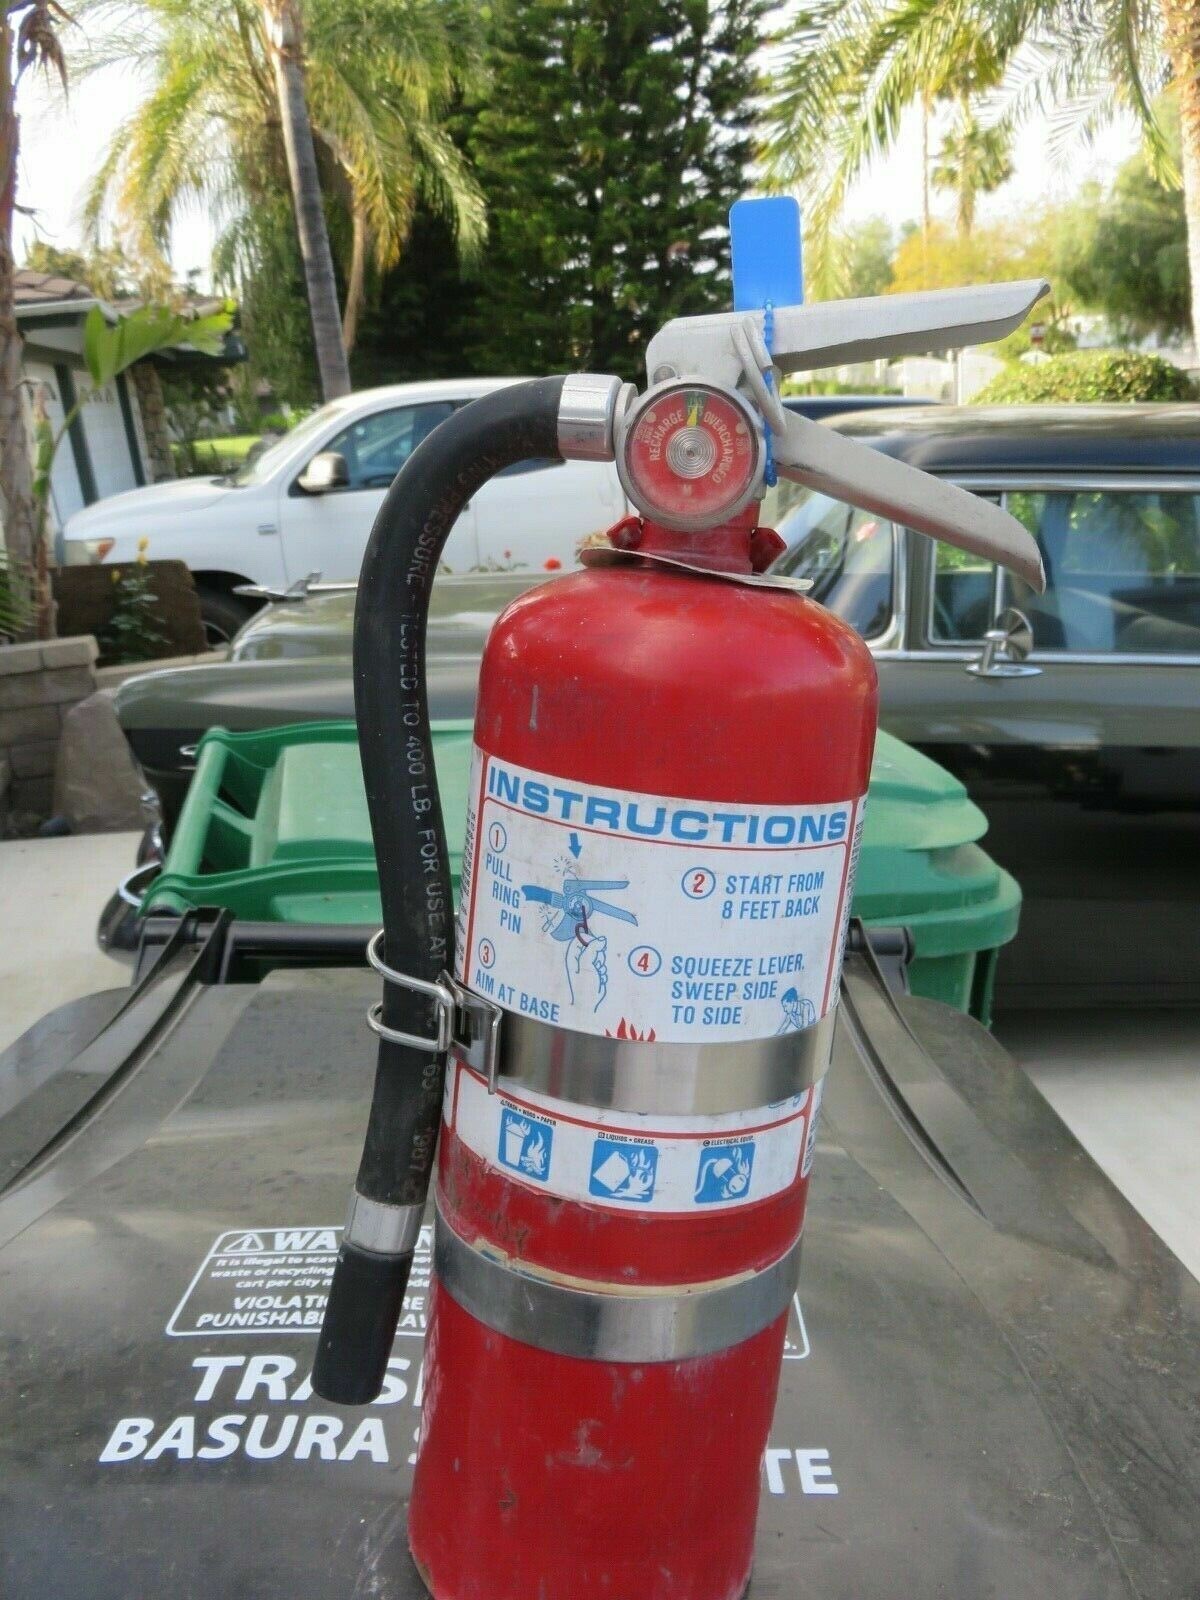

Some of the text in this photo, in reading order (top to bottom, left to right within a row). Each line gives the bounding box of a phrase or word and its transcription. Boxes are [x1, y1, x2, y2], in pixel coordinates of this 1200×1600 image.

[650, 409, 685, 462] RECHARGE
[703, 411, 734, 484] OVERCHARGED
[401, 702, 421, 728] TO
[404, 735, 427, 775] 400
[410, 783, 432, 822] LB.
[488, 765, 848, 845] INSTRUCTIONS
[417, 829, 441, 875] FOR
[486, 852, 514, 882] PULL
[492, 879, 521, 909] RING
[725, 871, 825, 896] START FROM
[425, 881, 447, 927] USE
[721, 896, 820, 920] 8 FEET BACK
[500, 909, 522, 935] PIN
[429, 935, 448, 963] AT
[671, 955, 754, 978] SQUEEZE
[475, 969, 561, 1023] AIM AT BASE
[671, 979, 778, 1002] SWEEP SIDE
[672, 1005, 742, 1026] TO SIDE
[211, 1265, 336, 1278] waste or recycling
[287, 1256, 303, 1265] to
[235, 1278, 264, 1288] cart
[265, 1279, 291, 1289] per
[293, 1278, 321, 1289] city
[233, 1296, 425, 1310] VIOLATI RE
[99, 1414, 390, 1463] BASURA
